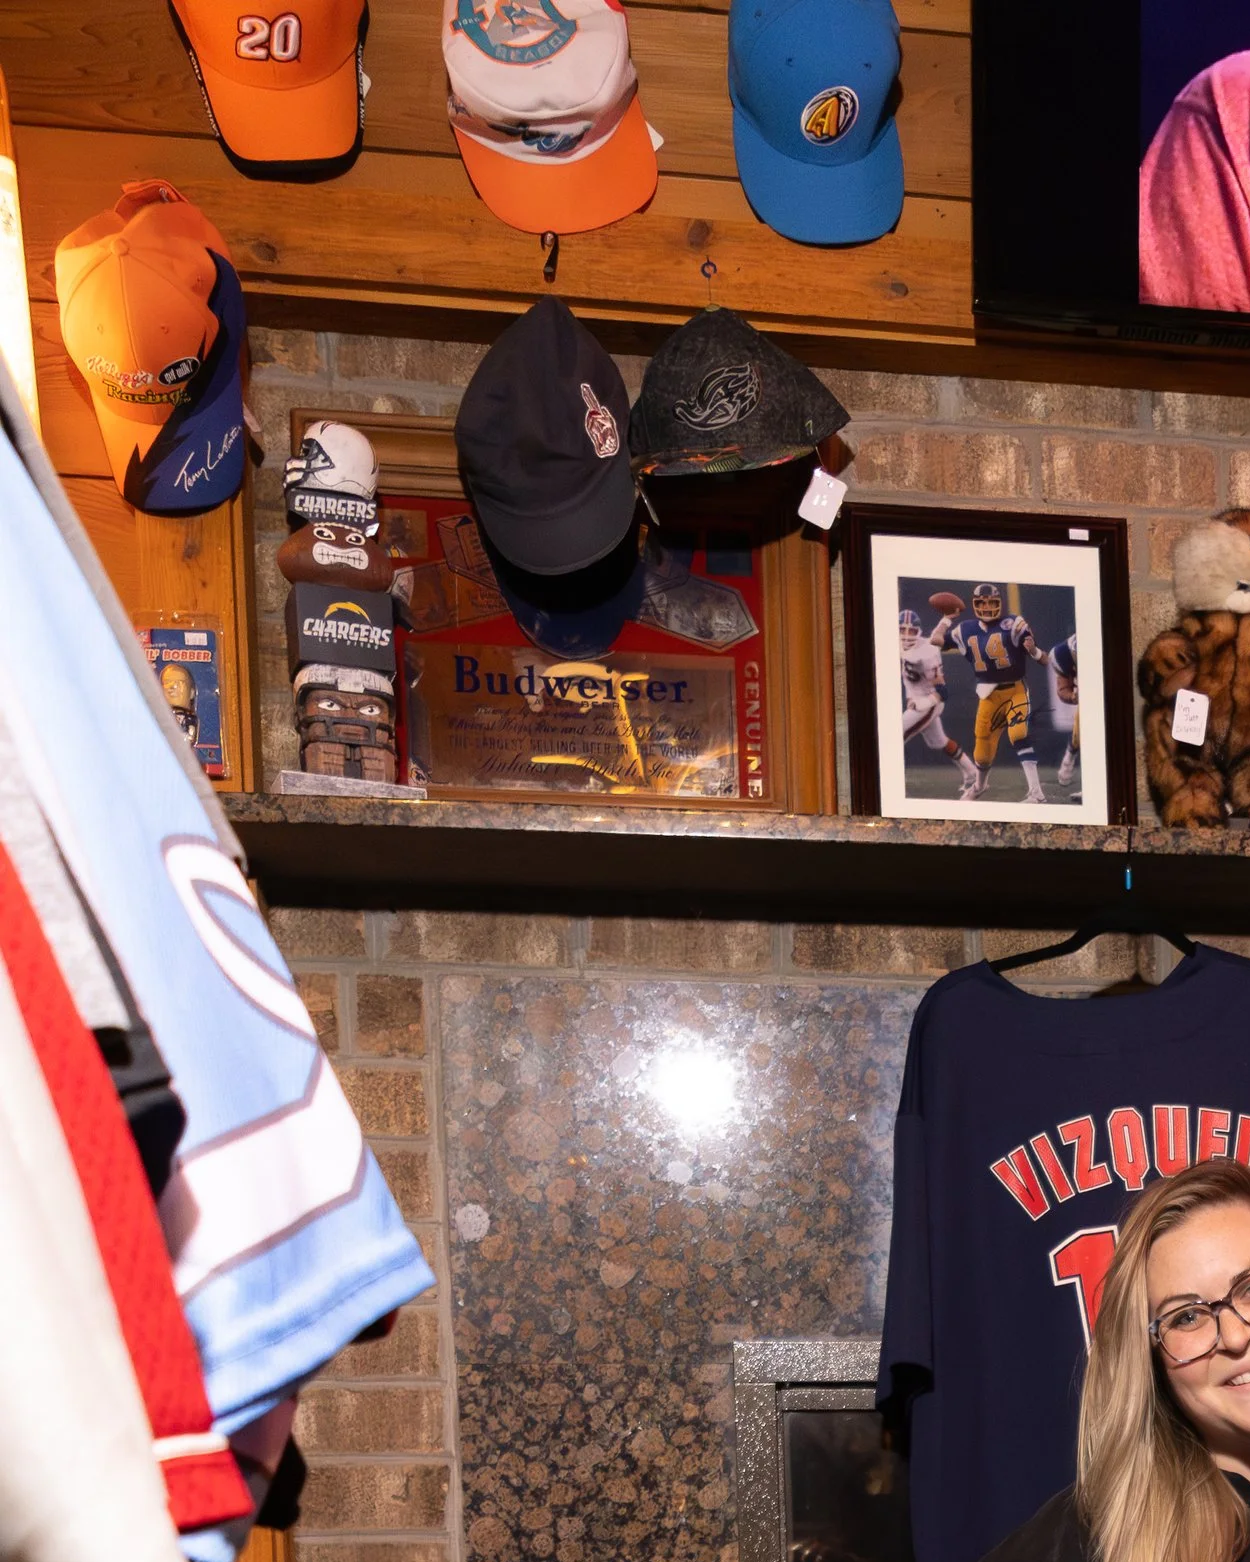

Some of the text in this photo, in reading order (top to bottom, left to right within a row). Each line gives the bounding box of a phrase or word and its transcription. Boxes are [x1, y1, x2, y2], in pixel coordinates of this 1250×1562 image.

[235, 12, 302, 63] 20
[805, 95, 840, 138] A
[163, 359, 194, 385] got milk?
[103, 379, 186, 407] Racing
[294, 494, 377, 521] CHARGERS
[302, 616, 393, 647] CHARGERS
[162, 649, 211, 663] BOBBER
[967, 632, 1010, 672] 14
[744, 661, 764, 798] GENUINE
